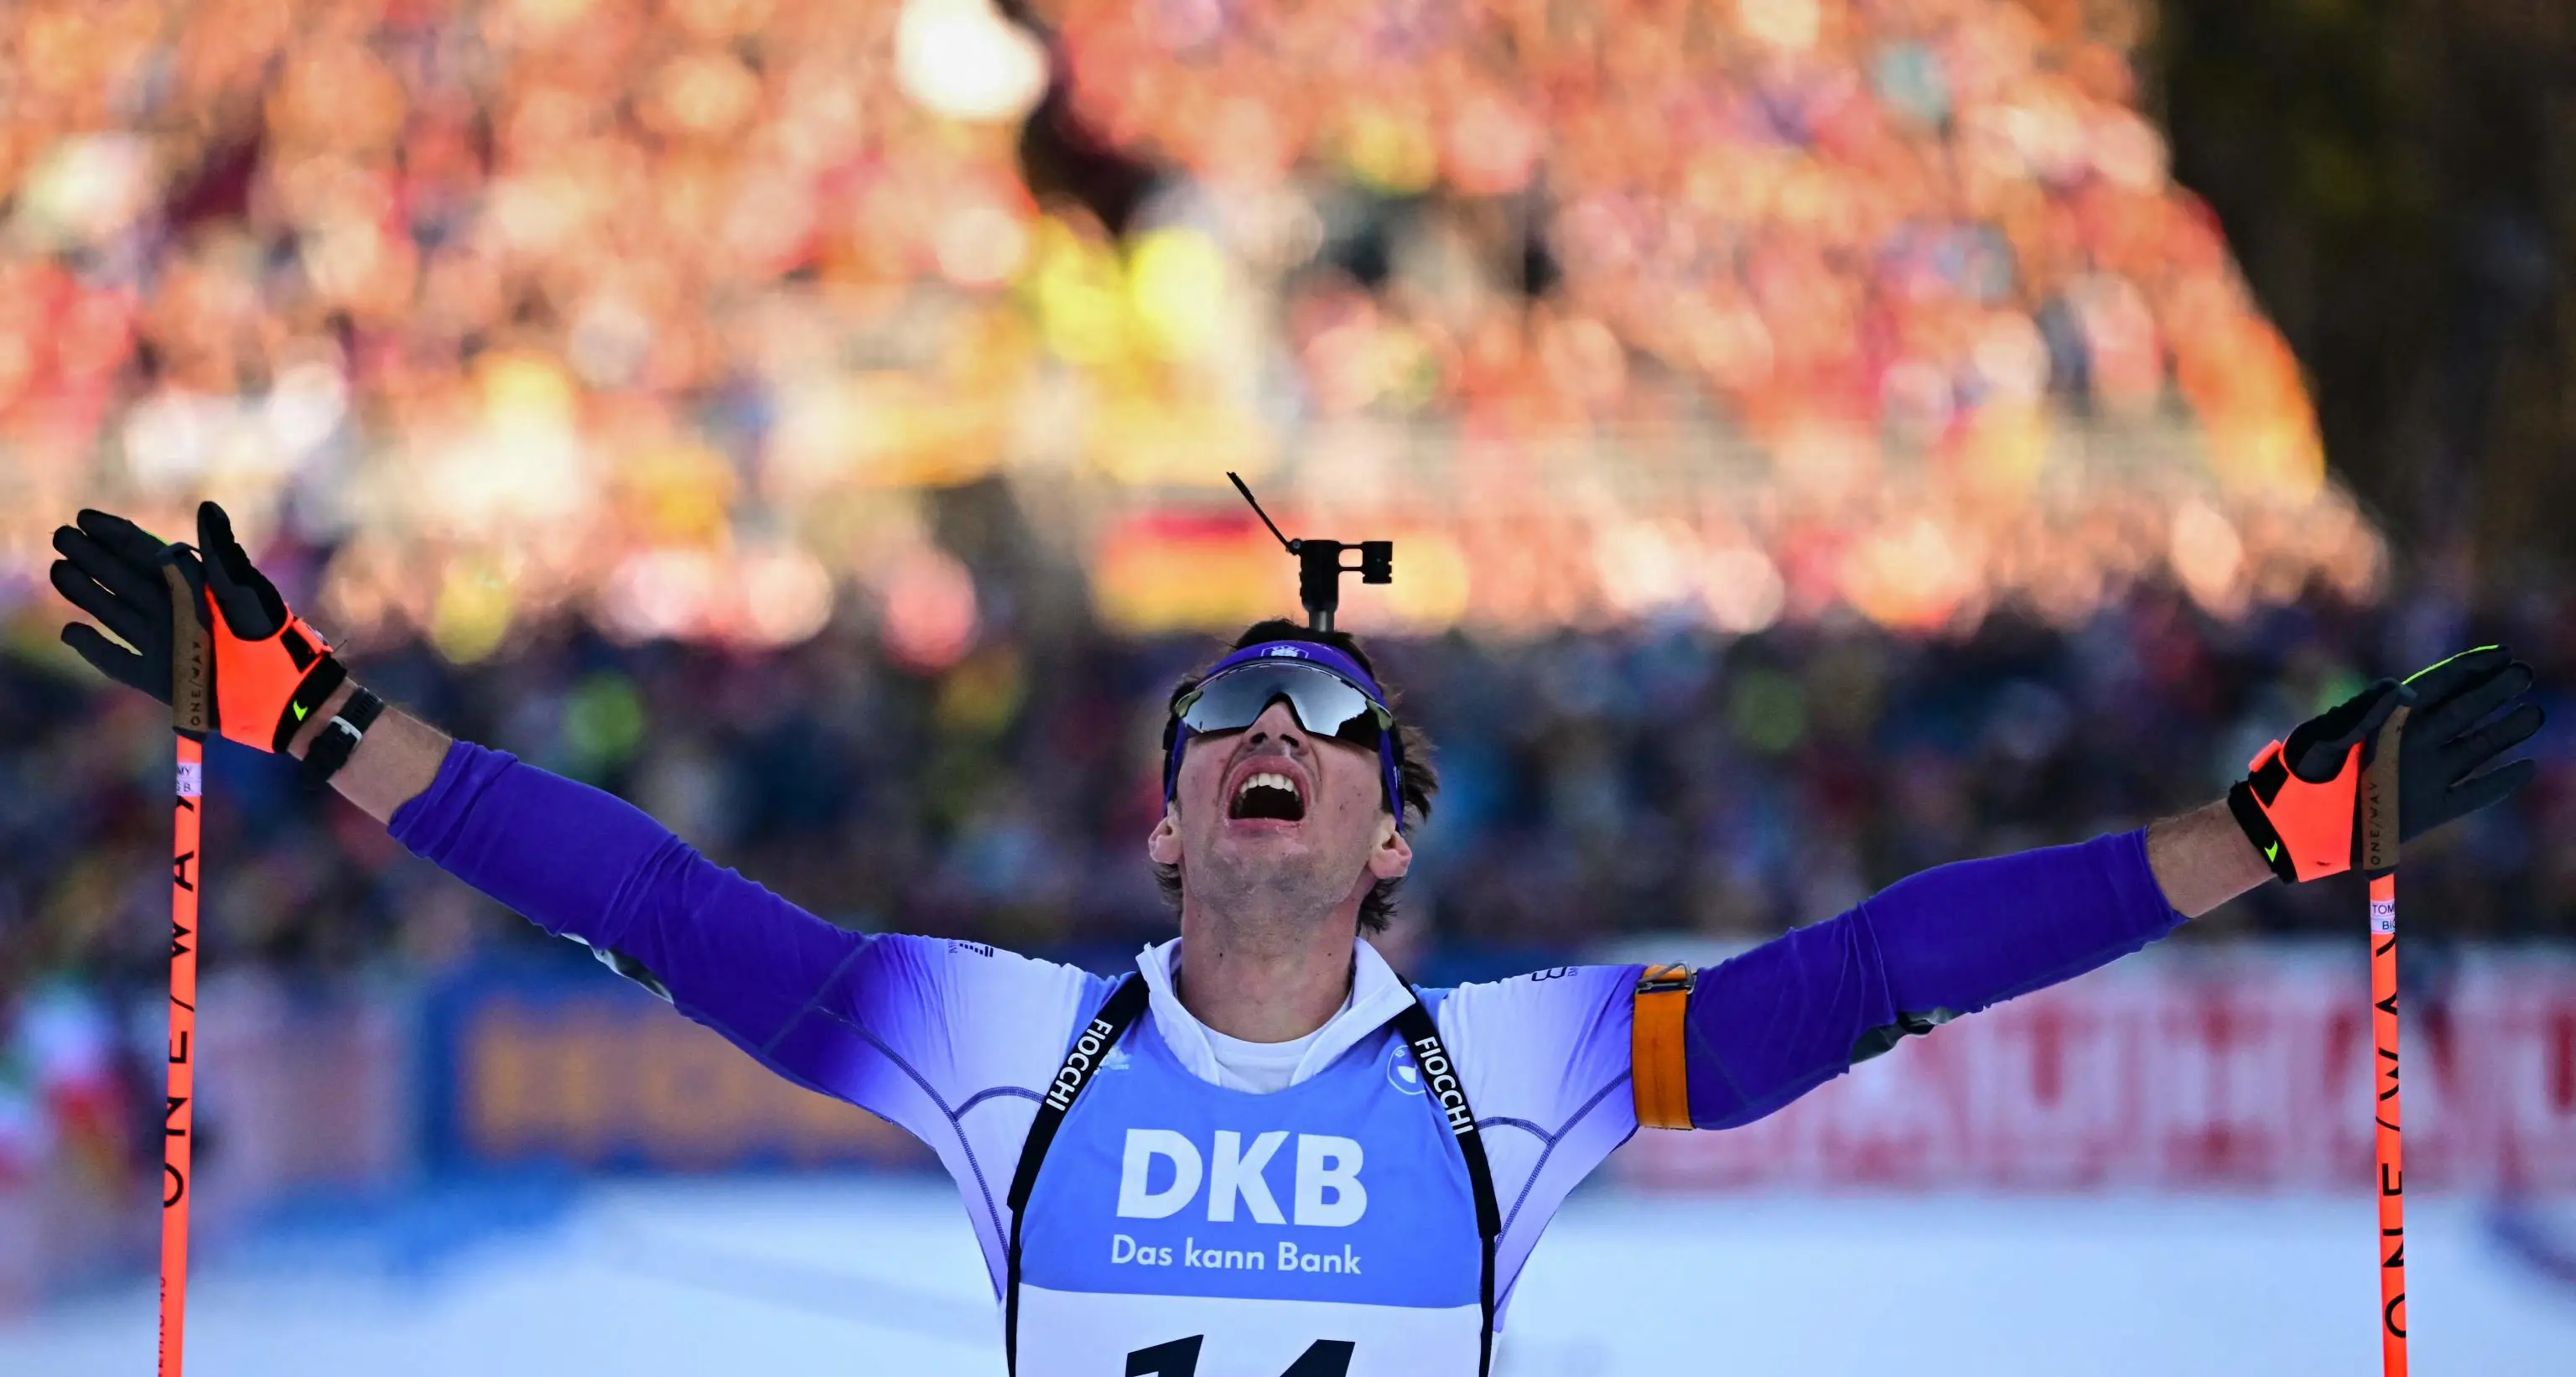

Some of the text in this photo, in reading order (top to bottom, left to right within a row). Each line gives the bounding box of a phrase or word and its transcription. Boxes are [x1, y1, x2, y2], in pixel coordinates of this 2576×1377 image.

[189, 641, 202, 726] ONE/WAY
[2366, 782, 2384, 865] ONE/WAY
[1046, 1018, 1114, 1111] FIOCCHI
[1415, 1036, 1473, 1135] FIOCCHI
[1116, 1129, 1368, 1227] DKB
[1112, 1235, 1361, 1274] Das kann Bank
